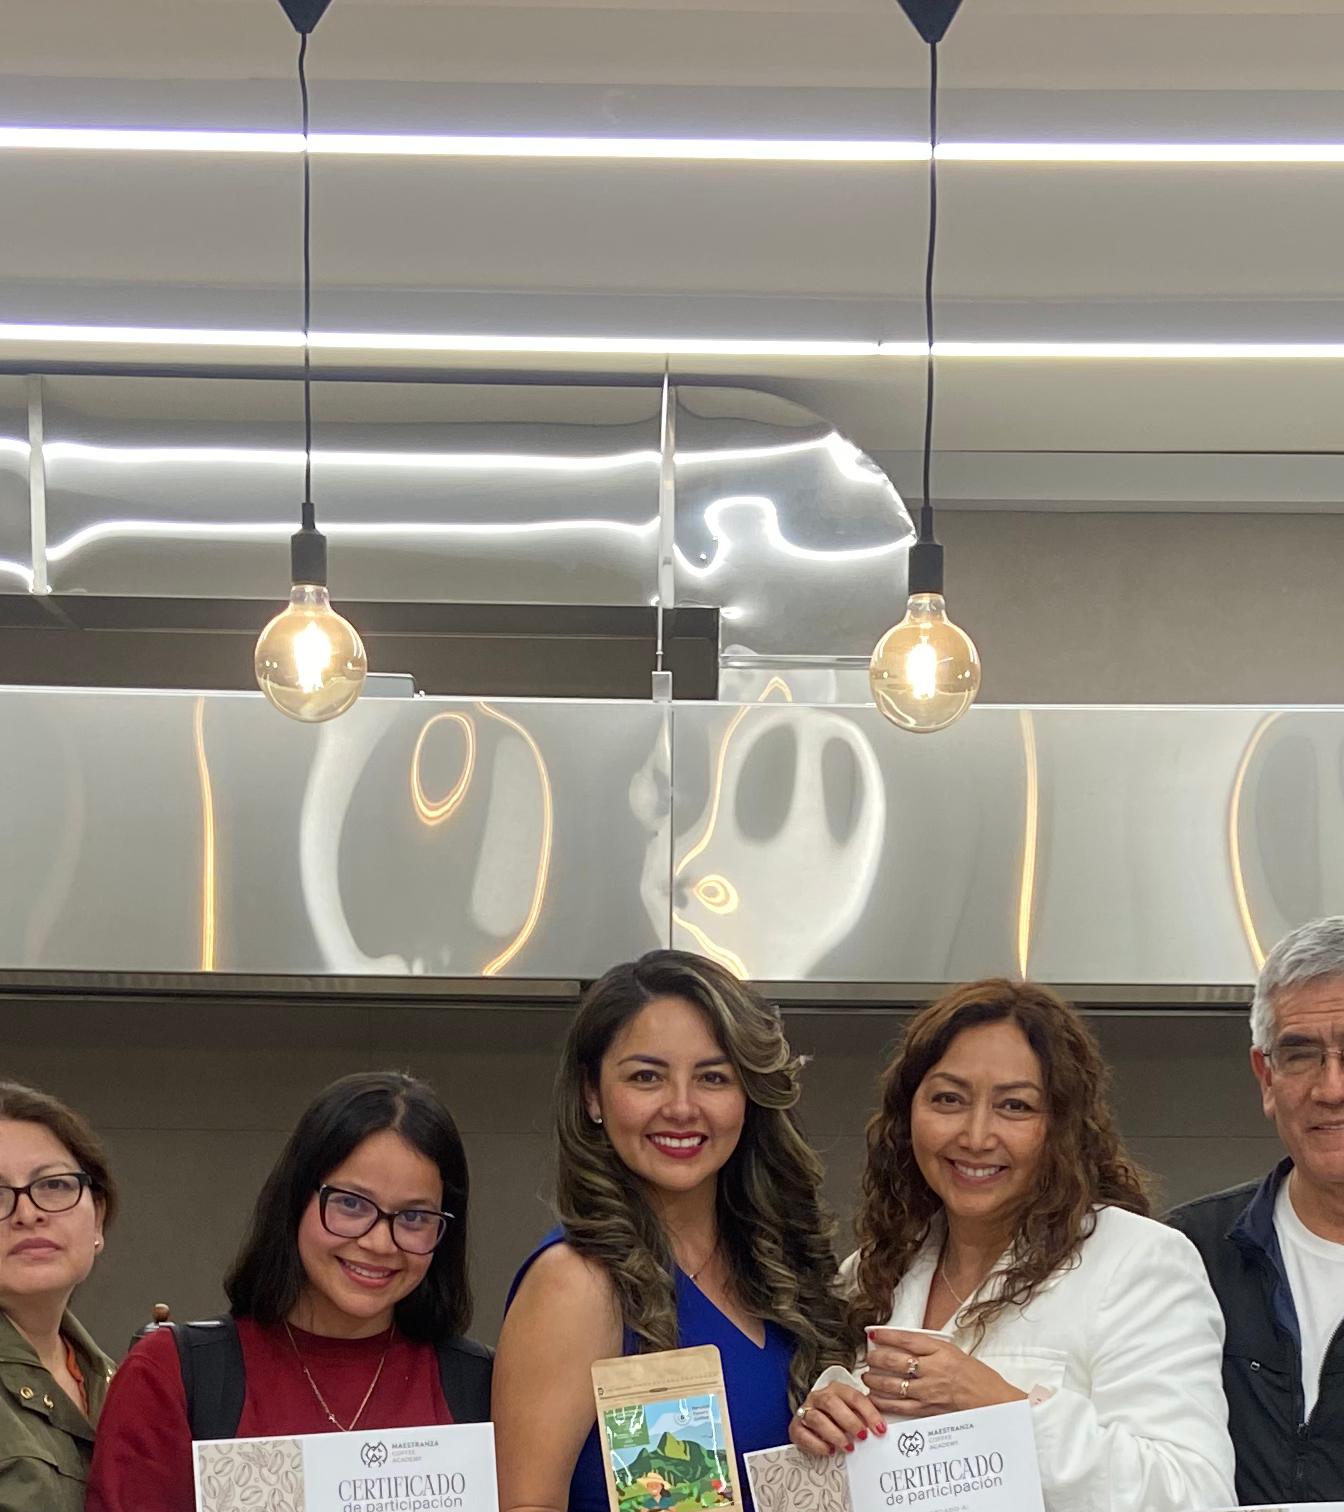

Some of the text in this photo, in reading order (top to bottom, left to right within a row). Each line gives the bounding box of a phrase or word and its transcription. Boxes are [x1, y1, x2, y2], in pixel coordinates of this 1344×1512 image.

[927, 1423, 974, 1436] MAESTRANZA
[392, 1440, 439, 1449] MAESTRANZA
[338, 1472, 466, 1501] CERTIFICADO
[879, 1451, 1004, 1494] CERTIFICADO
[886, 1475, 1003, 1506] de participación
